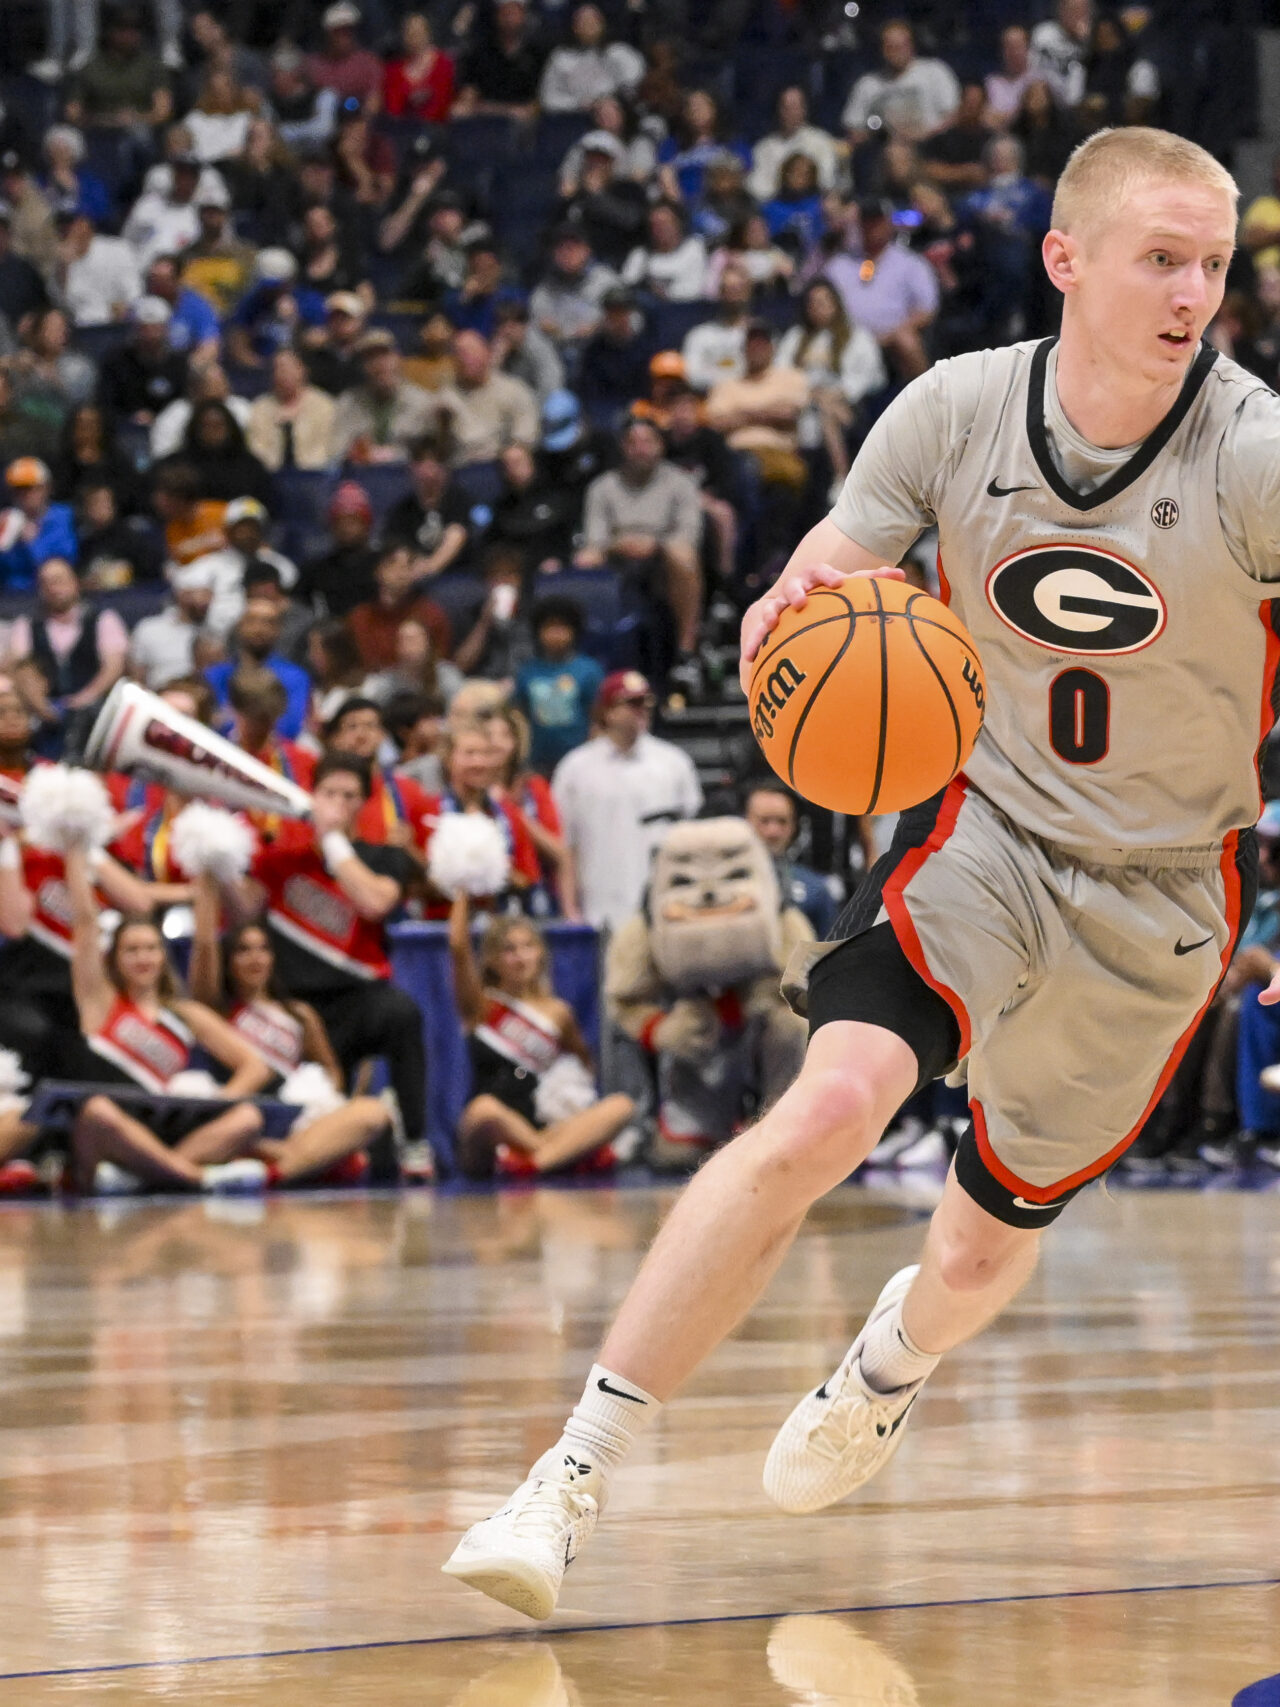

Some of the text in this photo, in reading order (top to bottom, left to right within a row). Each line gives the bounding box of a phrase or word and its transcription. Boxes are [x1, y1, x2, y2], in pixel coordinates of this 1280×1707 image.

[1154, 501, 1177, 526] SEC
[993, 549, 1160, 650] G
[1049, 667, 1110, 764] 0
